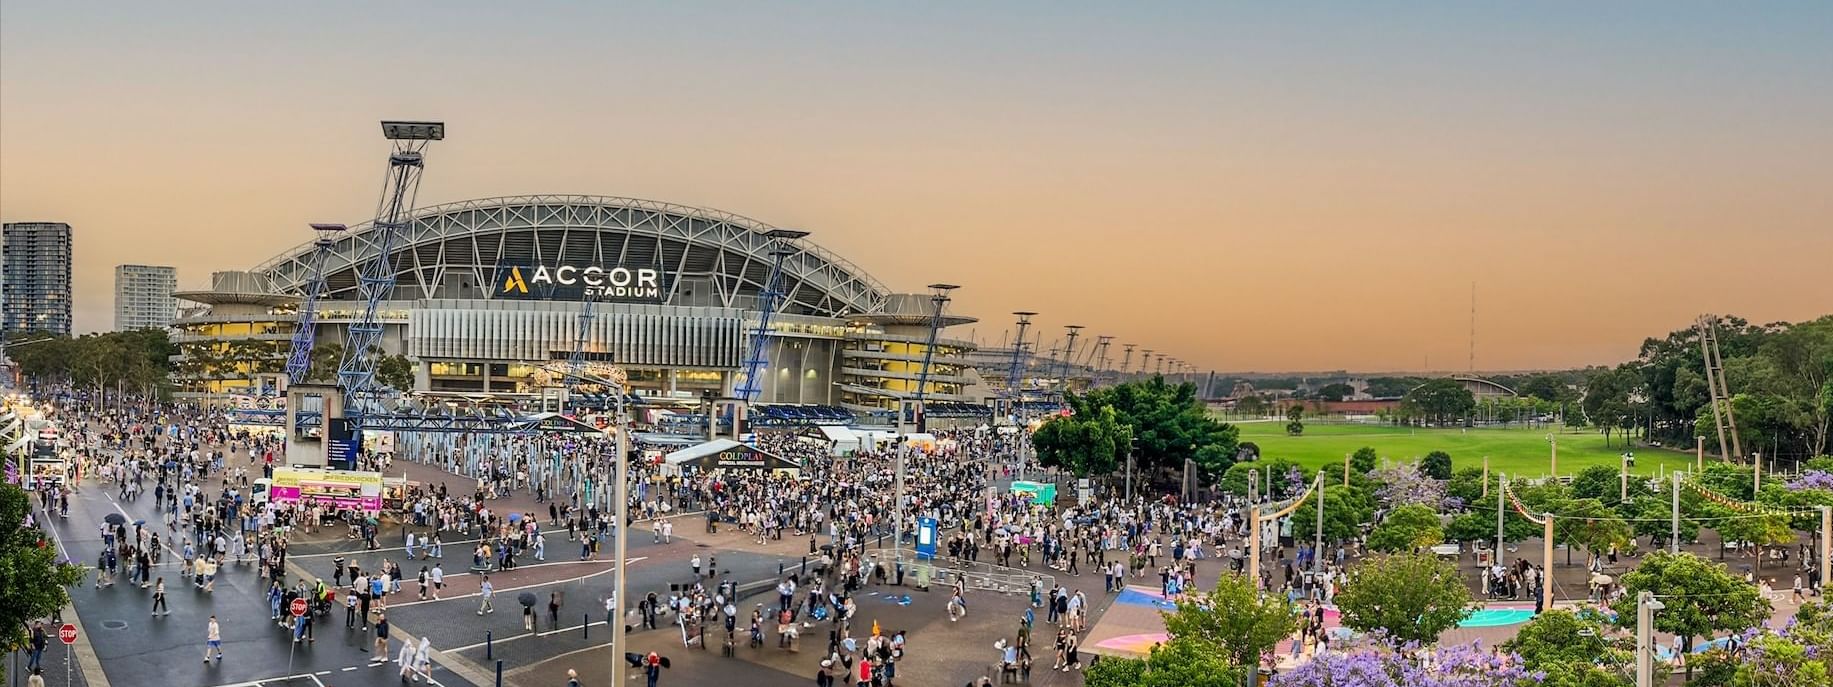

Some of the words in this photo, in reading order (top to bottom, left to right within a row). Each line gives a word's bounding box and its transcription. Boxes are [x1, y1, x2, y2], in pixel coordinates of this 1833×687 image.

[531, 265, 657, 287] ACCOR
[584, 286, 658, 298] STADIUM
[719, 451, 764, 460] COLDPLAY
[291, 603, 306, 611] STOP
[60, 629, 76, 638] STOP
